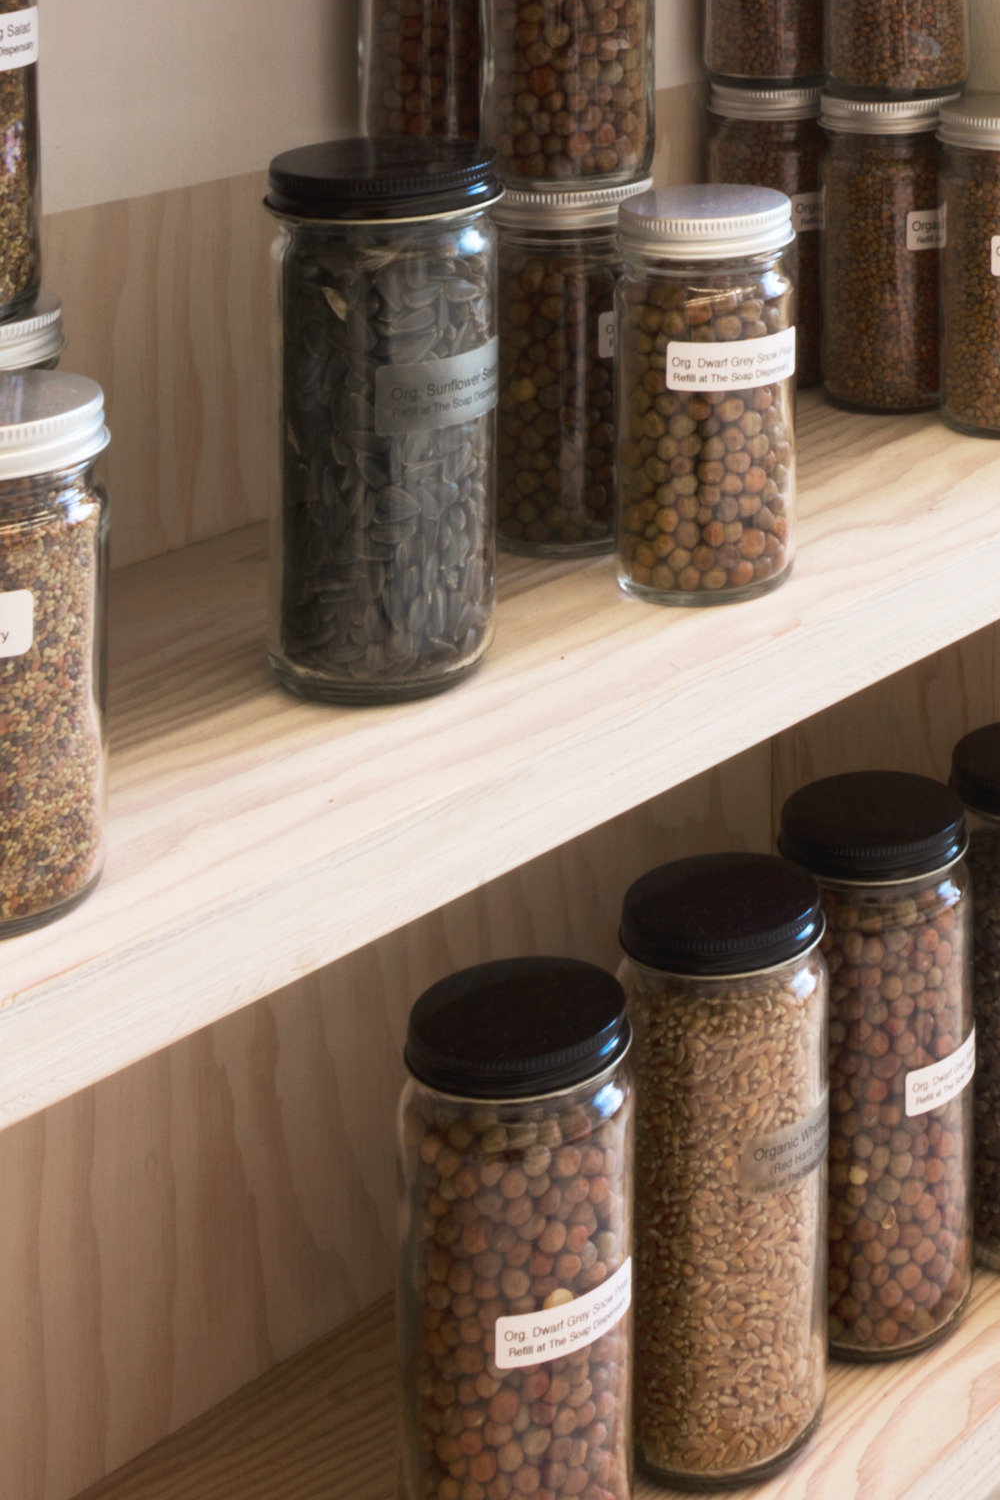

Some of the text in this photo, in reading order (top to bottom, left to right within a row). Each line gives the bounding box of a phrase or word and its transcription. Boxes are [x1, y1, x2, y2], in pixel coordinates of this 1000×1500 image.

[7, 20, 31, 37] Salad
[671, 356, 693, 369] Org.
[697, 357, 727, 368] Dwarf
[731, 355, 754, 367] Grey
[757, 351, 777, 364] Snow
[673, 372, 696, 382] Refill
[699, 374, 707, 382] at
[711, 373, 727, 382] The
[731, 372, 752, 382] Soap
[391, 387, 421, 402] Org.
[427, 374, 480, 397] Sunflower
[433, 402, 450, 412] The
[453, 396, 473, 409] Soap
[754, 1137, 799, 1162] Organic
[532, 1320, 564, 1338] Dwarf
[567, 1310, 590, 1328] Grey
[592, 1295, 613, 1314] Snow
[508, 1345, 533, 1357] Refill
[536, 1343, 546, 1353] at
[549, 1337, 567, 1349] The
[569, 1325, 591, 1342] Soap
